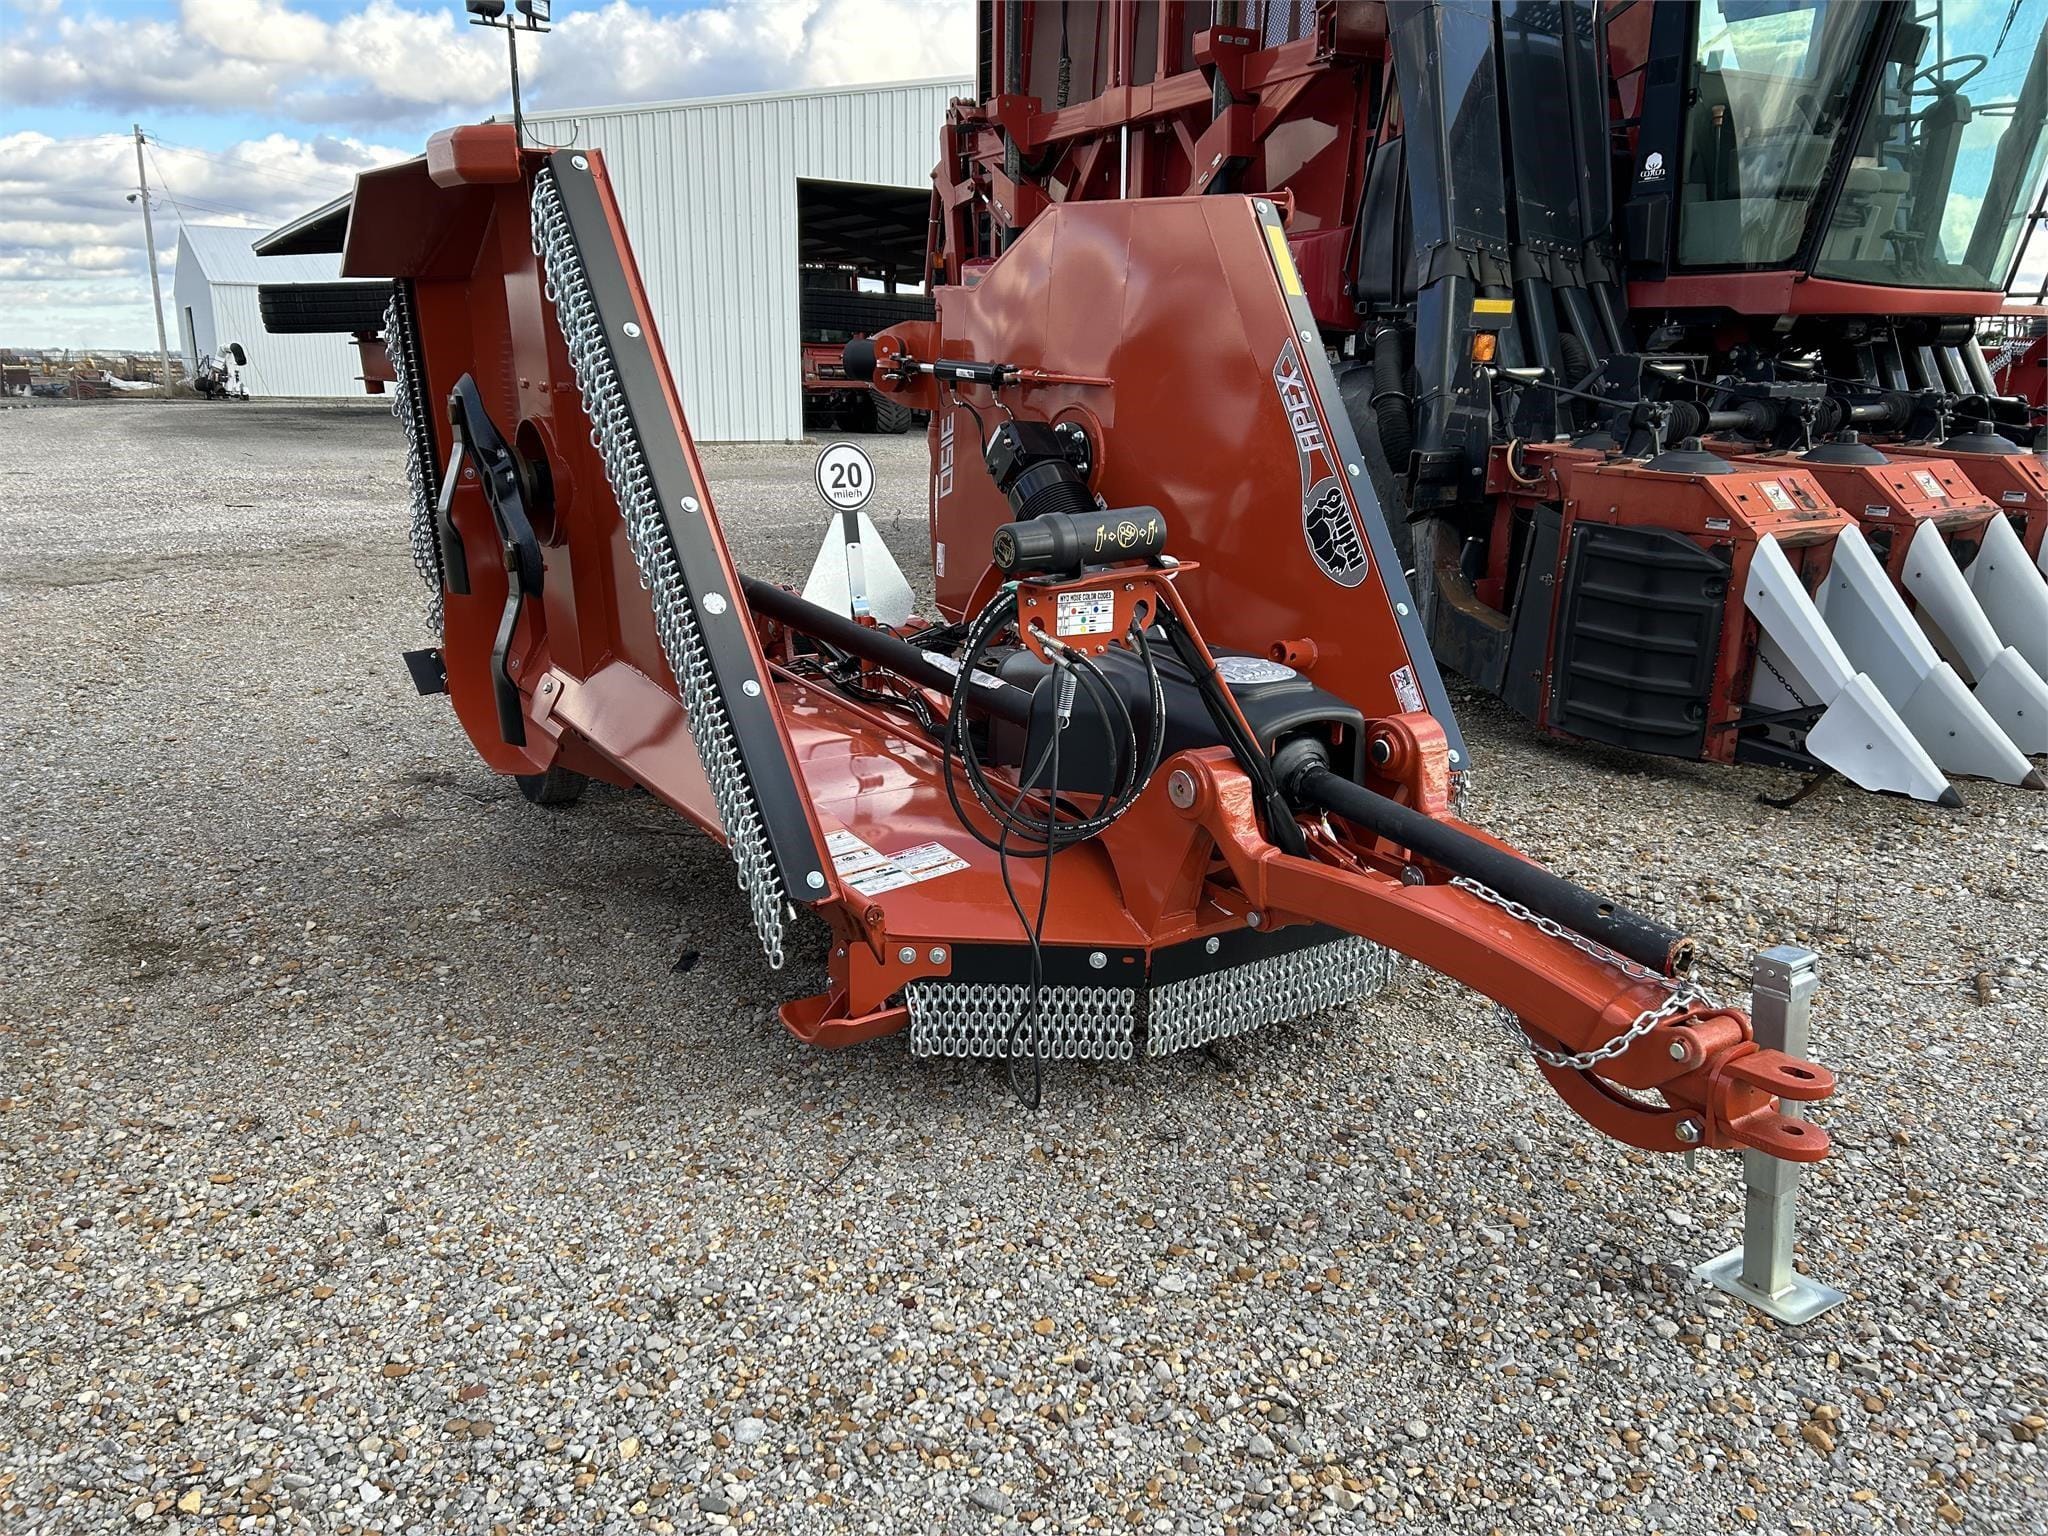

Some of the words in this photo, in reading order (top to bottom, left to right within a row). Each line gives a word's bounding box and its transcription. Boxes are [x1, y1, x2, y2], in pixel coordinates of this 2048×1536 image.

[1277, 367, 1325, 453] APEX
[830, 462, 862, 488] 20
[939, 411, 954, 498] 3150
[833, 489, 863, 498] mile/h
[1326, 487, 1365, 571] RHINO
[1071, 594, 1082, 602] HOSE
[1083, 593, 1097, 601] COLOR
[1098, 592, 1111, 600] CODES
